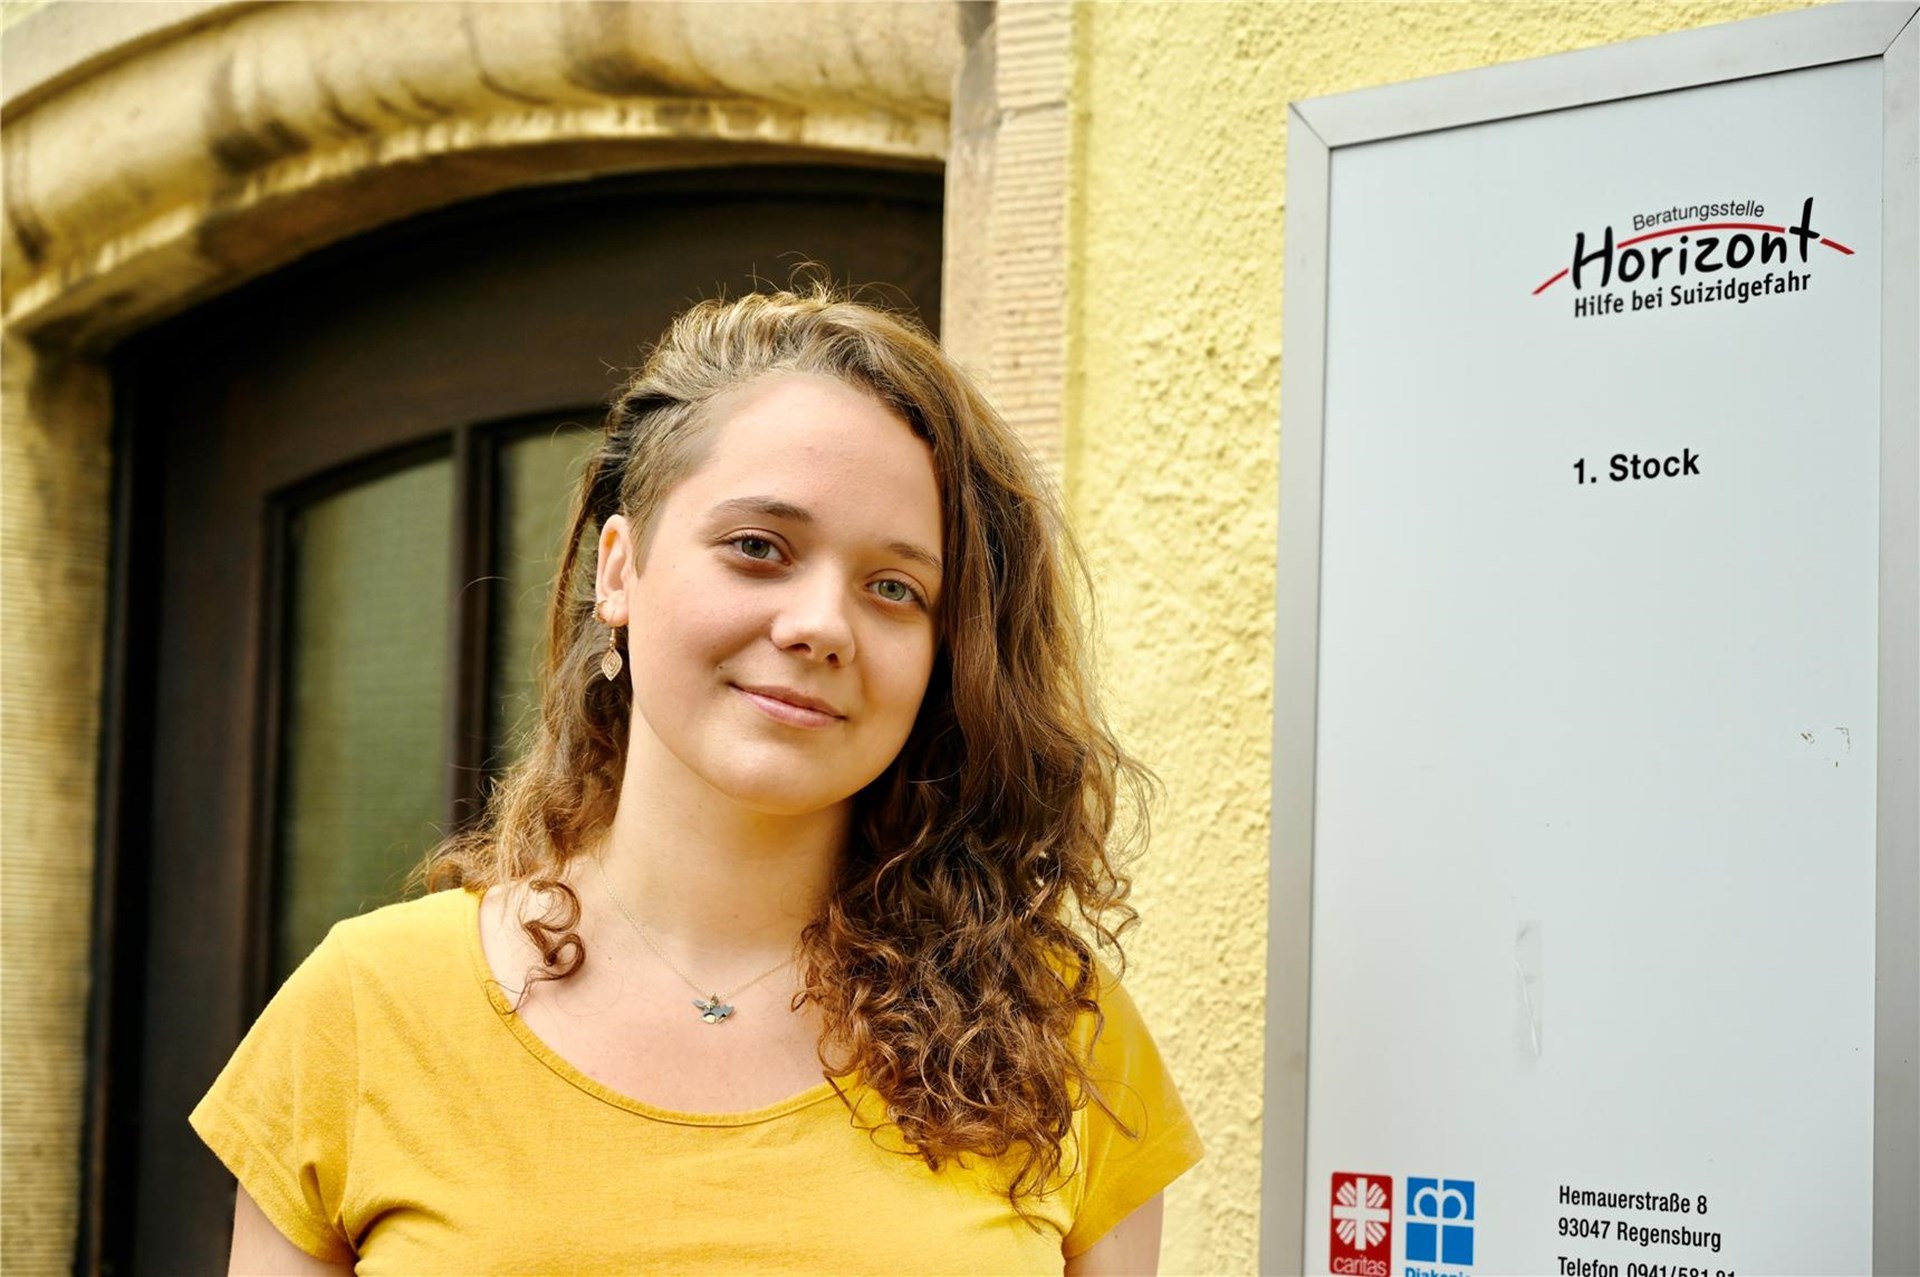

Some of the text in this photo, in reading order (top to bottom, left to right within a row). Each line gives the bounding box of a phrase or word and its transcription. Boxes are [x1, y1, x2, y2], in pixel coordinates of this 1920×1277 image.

[1633, 200, 1765, 231] Beratungsstelle
[1572, 196, 1821, 290] Horizont
[1574, 270, 1811, 318] Hilfe bei Suizidgefahr
[1573, 448, 1700, 484] 1. Stock
[1559, 1185, 1708, 1215] Hemauerstraße 8
[1558, 1217, 1721, 1253] 93047 Regensburg
[1333, 1254, 1387, 1276] caritas
[1558, 1256, 1619, 1277] Telefon
